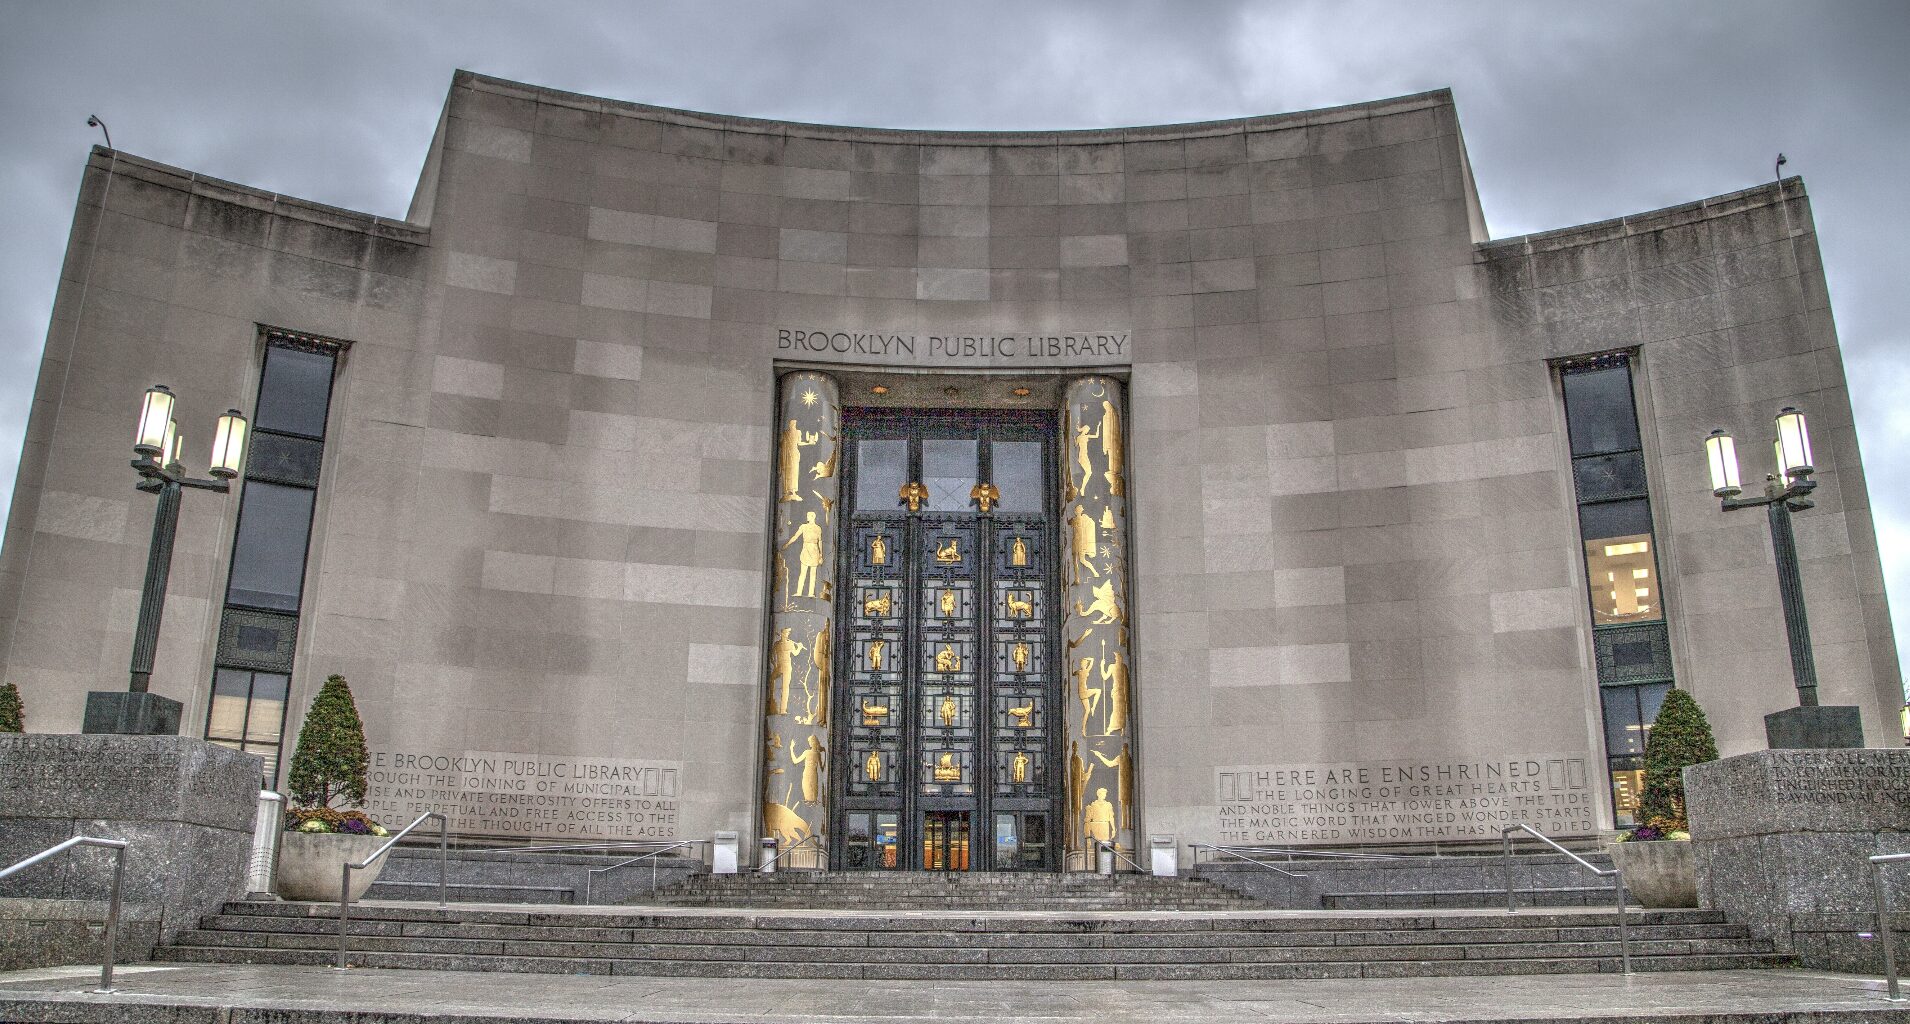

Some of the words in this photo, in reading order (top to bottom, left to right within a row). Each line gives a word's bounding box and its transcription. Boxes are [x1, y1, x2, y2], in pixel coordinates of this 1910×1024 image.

[778, 329, 915, 355] BROOKLYN
[928, 336, 1016, 358] PUBLIC
[1027, 334, 1128, 357] LIBRARY
[395, 753, 496, 773] BROOKLYN
[503, 760, 567, 778] PUBLIC
[572, 764, 644, 781] LIBRARY
[1772, 753, 1867, 765] INGERSOLL
[1256, 770, 1316, 786] HERE
[1325, 768, 1370, 785] ARE
[1381, 761, 1541, 783] ENSHRINED
[1772, 766, 1791, 777] TO
[1796, 765, 1910, 778] COMMEMORATE
[366, 771, 420, 785] ROUGH
[427, 774, 456, 787] THE
[463, 777, 526, 791] JOINING
[536, 780, 557, 792] OF
[564, 782, 641, 796] MUNICIPAL
[1255, 790, 1286, 801] THE
[1295, 787, 1372, 801] LONGING
[1379, 786, 1401, 798] OF
[1409, 784, 1464, 797] GREAT
[1471, 780, 1541, 795] HEARTS
[394, 787, 426, 799] AND
[431, 789, 484, 803] PRIVATE
[489, 793, 577, 807] GENEROSITY
[581, 797, 632, 810] OFFERS
[635, 799, 652, 810] TO
[654, 800, 676, 811] ALL
[1219, 805, 1247, 816] AND
[1250, 804, 1295, 815] NOBLE
[1301, 802, 1355, 814] THINGS
[1360, 801, 1397, 812] THAT
[1402, 799, 1453, 811] TOWER
[1459, 797, 1510, 809] ABOVE
[1515, 795, 1545, 806] THE
[1551, 793, 1590, 805] TIDE
[1776, 791, 1848, 804] RAYMOND
[1848, 791, 1880, 804] VAIL
[344, 799, 398, 812] OPLE
[406, 802, 486, 816] PERPETUAL
[488, 807, 520, 818] AND
[525, 808, 559, 820] FREE
[567, 810, 623, 822] ACCESS
[627, 812, 645, 823] TO
[649, 813, 676, 824] THE
[1219, 818, 1246, 829] THE
[1249, 817, 1298, 828] MAGIC
[1303, 816, 1347, 827] WORD
[1351, 814, 1388, 825] THAT
[1393, 812, 1456, 824] WINGED
[1461, 809, 1530, 822] WONDER
[1536, 806, 1591, 819] STARTS
[449, 818, 476, 829] THE
[482, 819, 553, 833] THOUGHT
[557, 822, 576, 833] OF
[579, 824, 603, 835] ALL
[607, 825, 633, 836] THE
[637, 826, 675, 837] AGES
[1219, 831, 1249, 841] THE
[1255, 829, 1341, 841] GARNERED
[1348, 827, 1412, 839] WISDOM
[1416, 825, 1452, 837] THAT
[1456, 824, 1486, 835] HAS
[1551, 820, 1592, 832] DIED
